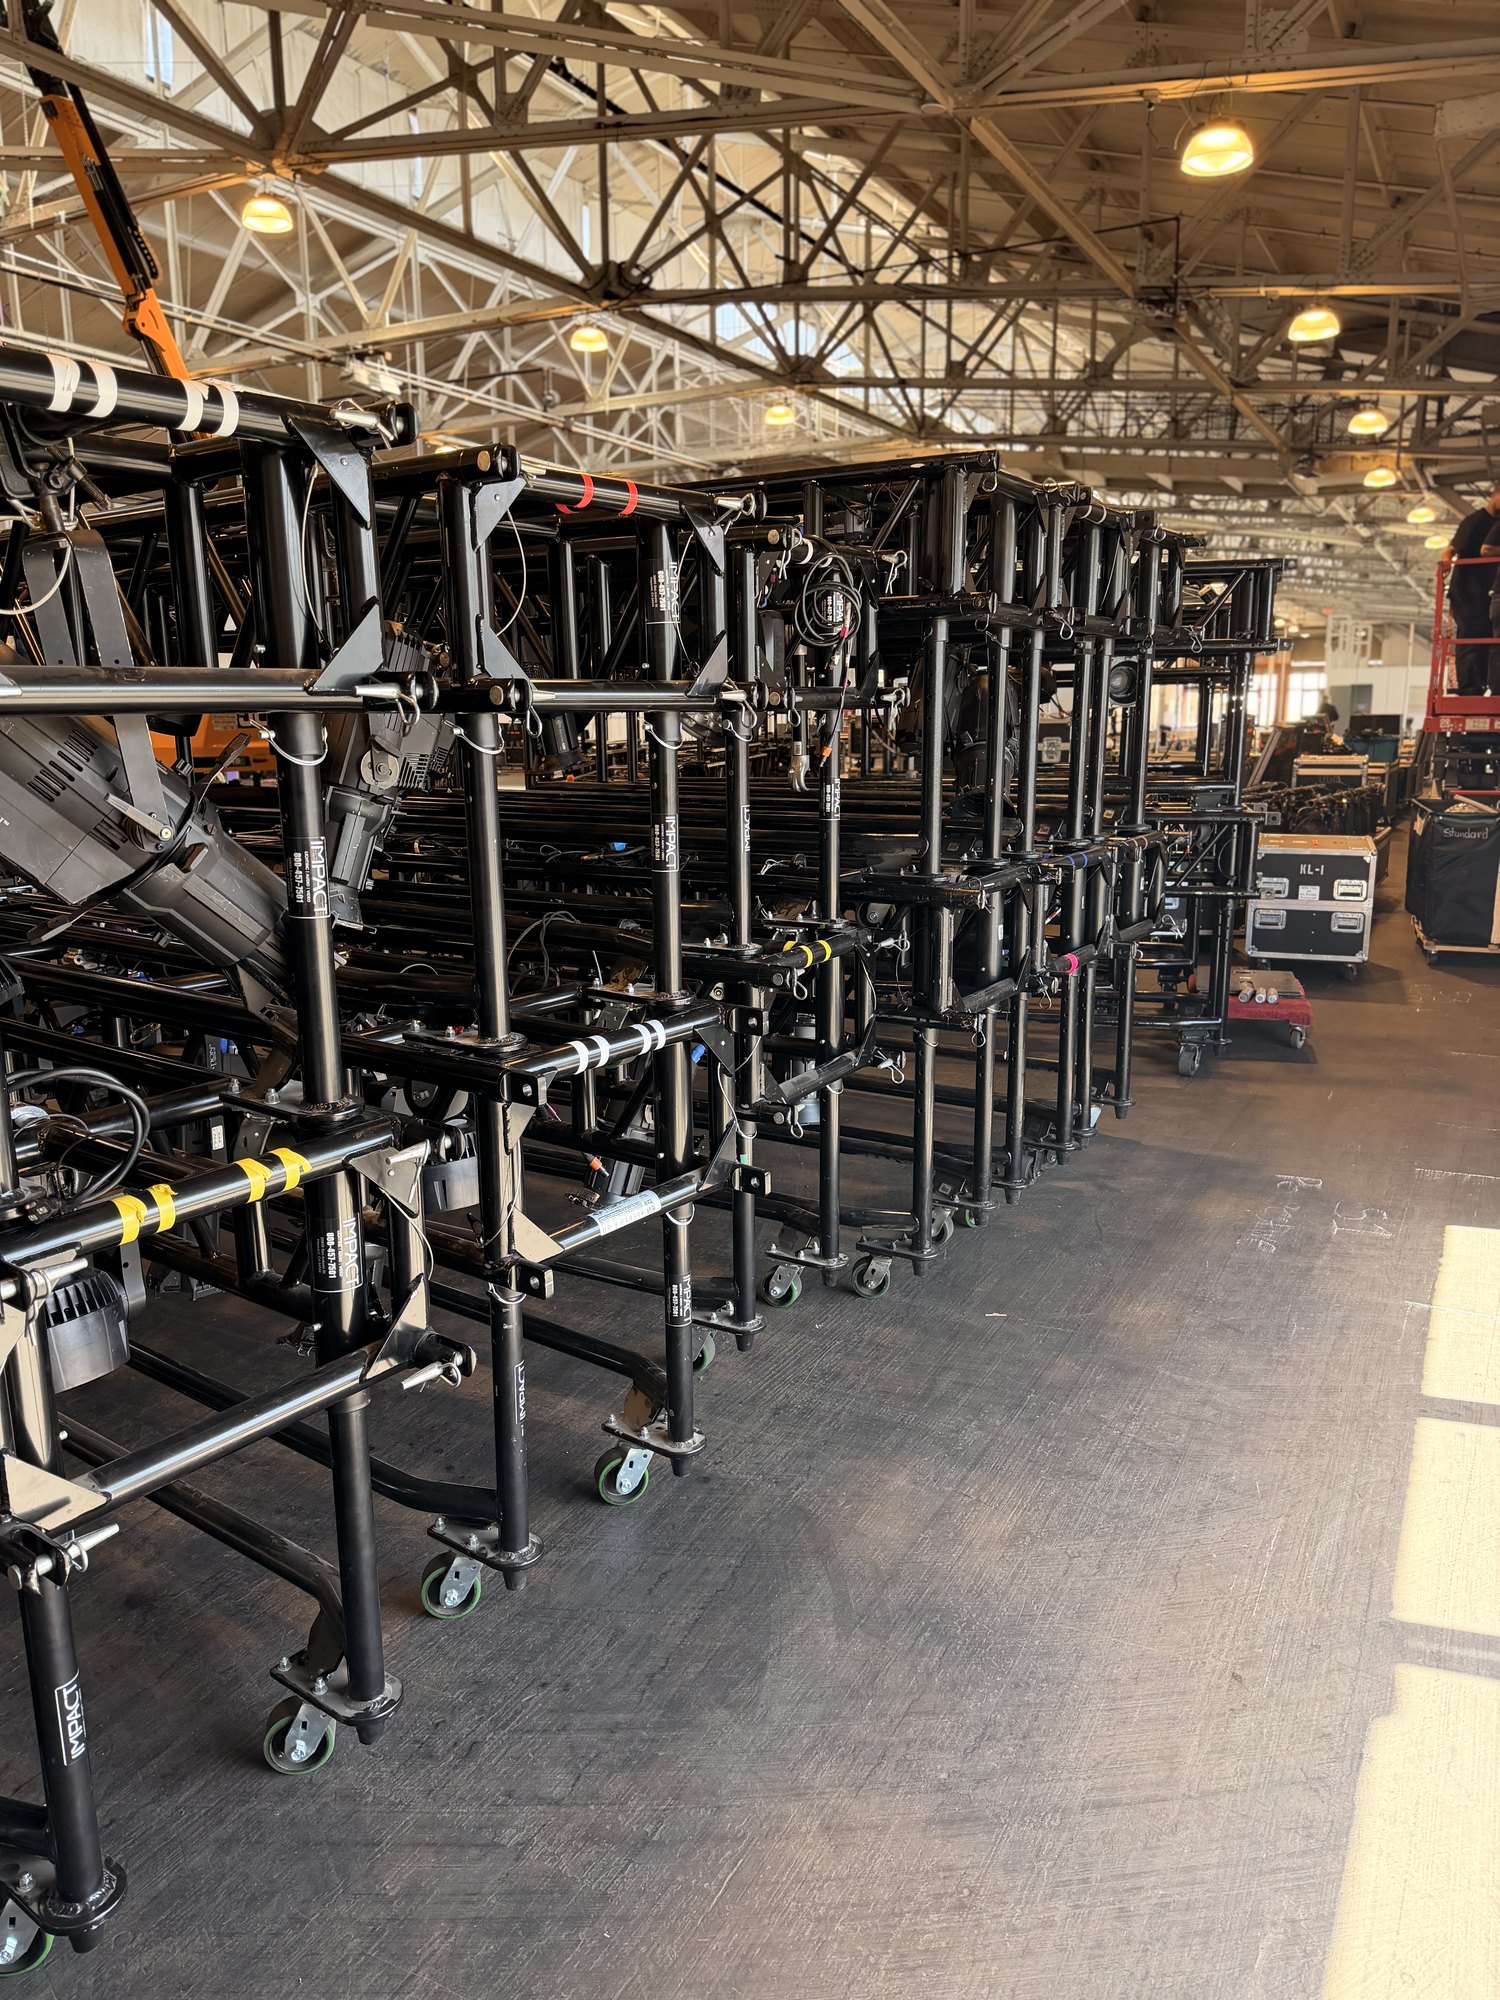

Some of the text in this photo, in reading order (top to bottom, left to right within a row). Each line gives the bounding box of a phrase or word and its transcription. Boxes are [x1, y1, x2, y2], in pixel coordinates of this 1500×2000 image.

[669, 561, 680, 621] IMPACT
[665, 816, 677, 870] IMPACT
[1443, 826, 1489, 839] Standard
[293, 852, 304, 904] 800-457-7501
[310, 840, 328, 915] IMPACT
[326, 1232, 337, 1279] 800-457-7501
[342, 1217, 360, 1285] IMPACT
[683, 1274, 692, 1322] IMPACT
[518, 1365, 527, 1421] IMPACT
[63, 1683, 86, 1760] IMPACT
